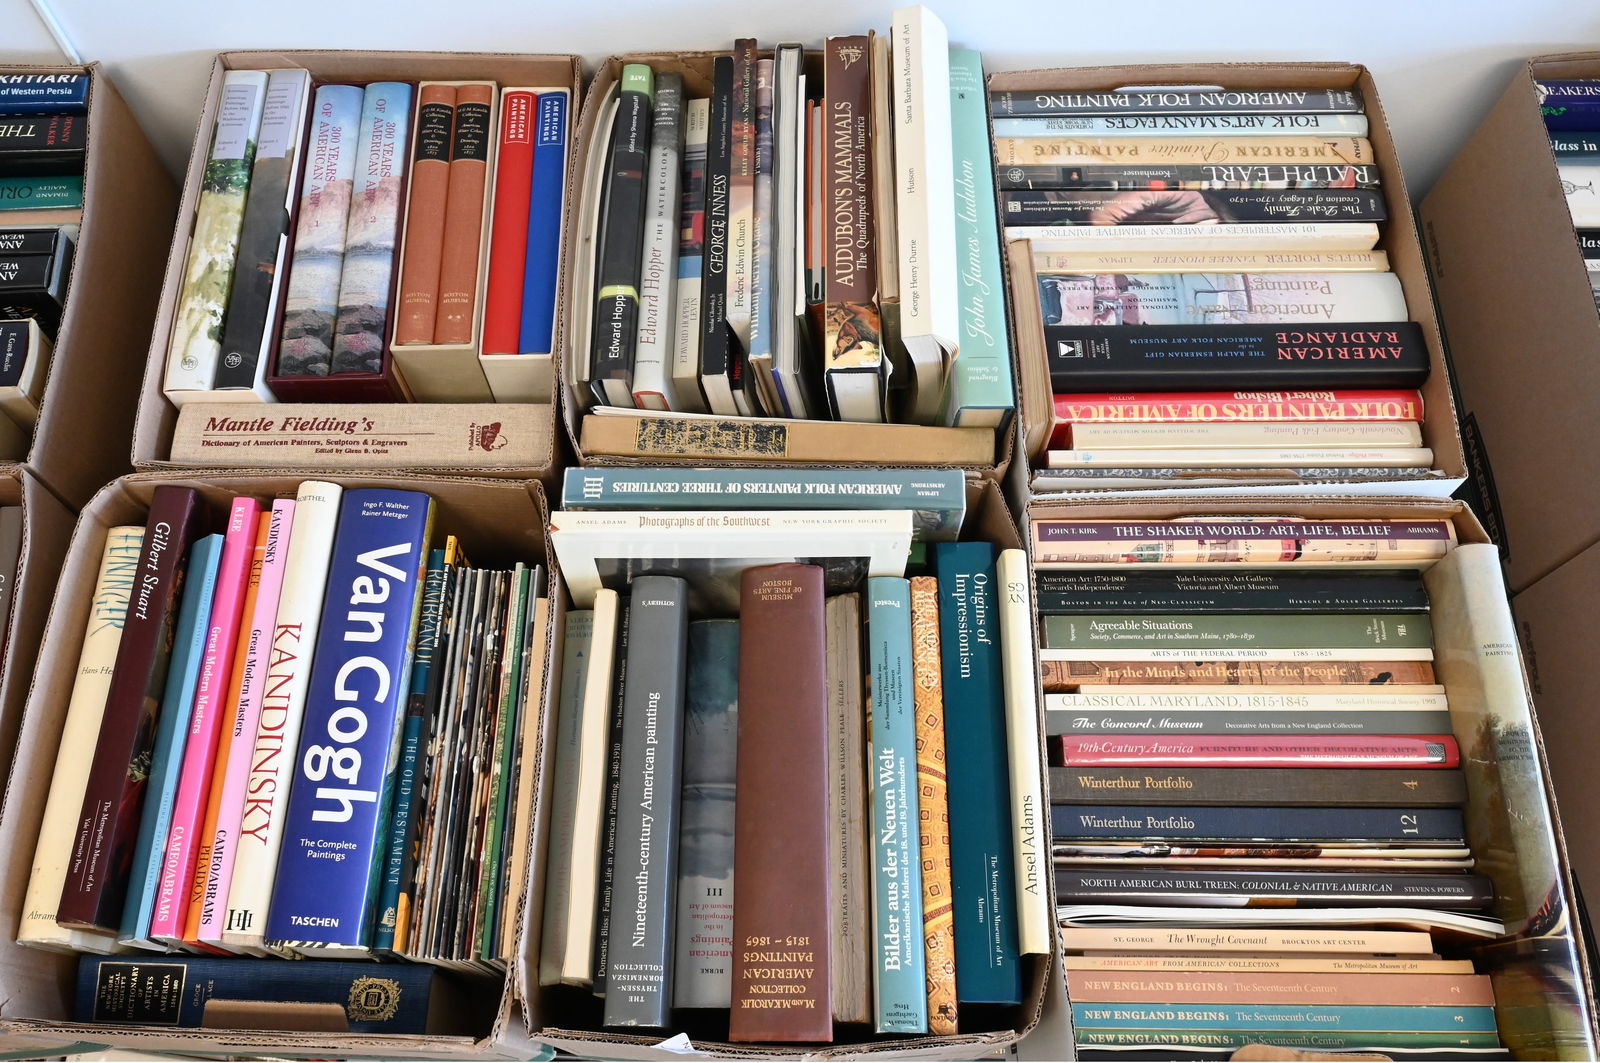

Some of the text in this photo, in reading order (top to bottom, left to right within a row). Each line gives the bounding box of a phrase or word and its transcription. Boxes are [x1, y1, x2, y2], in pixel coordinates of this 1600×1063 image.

[1, 86, 72, 96] of Western Persia
[376, 98, 386, 111] OF
[1034, 92, 1306, 108] AMERICAN FOLK PAINTING
[322, 103, 332, 116] OF
[508, 98, 518, 140] PAINTINGS
[516, 98, 526, 140] AMERICAN
[542, 100, 552, 142] PAINTINGS
[550, 100, 560, 141] AMERICAN
[312, 121, 332, 180] AMERICAN
[326, 126, 342, 182] 300 YEARS
[368, 117, 386, 176] AMERICAN
[381, 122, 397, 178] 300 YEARS
[1123, 170, 1170, 178] Kornhauser
[1202, 165, 1368, 182] RALPH EARL
[834, 102, 854, 287] AUDUBON'S MAMMALS
[854, 116, 870, 270] The Quadrupeds of North America
[709, 174, 726, 274] GEORGE INNESS
[1263, 205, 1362, 216] The Peale Family
[640, 146, 668, 344] Edward Hopper THE WATERCOLORS
[954, 160, 994, 347] John James Audubon
[735, 219, 746, 307] Frederic Edwin Church
[609, 285, 626, 358] Edward Hopper
[1275, 332, 1399, 344] RADIANCE
[1277, 347, 1403, 360] AMERICAN
[204, 416, 375, 434] Mantle Fielding's
[1066, 401, 1415, 421] FOLK PAINTERS OF AMERICA
[202, 439, 241, 448] Dictionary
[291, 438, 323, 448] Painters,
[326, 438, 360, 448] Sculptors
[362, 438, 369, 446] &
[371, 438, 408, 448] Engravers
[612, 481, 903, 496] AMERICAN FOLK PAINTERS OF THREE CENTURIES
[231, 506, 245, 532] KLEE
[1113, 525, 1392, 537] THE SHAKER WORLD: ART, LIFE, BELIEF
[264, 508, 283, 565] KANDINSKY
[135, 521, 171, 620] Gilbert Stuart
[249, 559, 262, 589] KLEE
[874, 600, 900, 608] Prestel
[970, 573, 992, 644] Origins of
[952, 573, 973, 679] Impressionism
[1090, 620, 1193, 633] Agreeable Situations
[192, 626, 222, 734] Great Modern Masters
[234, 629, 262, 737] Great Modern Masters
[303, 542, 412, 823] Van Gogh
[240, 622, 302, 846] KANDINSKY
[1072, 717, 1204, 729] The Concord Museum
[1078, 776, 1193, 789] Winterthur Portfolio
[1402, 780, 1418, 790] 4
[102, 800, 112, 812] The
[388, 737, 418, 885] THE OLD TESTAMENT
[632, 692, 660, 948] Nineteenth-century American painting
[94, 813, 109, 849] Metropolitan
[1080, 815, 1195, 829] Winterthur Portfolio
[1400, 814, 1419, 835] 12
[73, 818, 92, 874] Yale University Press
[299, 839, 357, 850] The Complete
[307, 850, 346, 860] Paintings
[879, 747, 902, 971] Bilder aus der Neuen Welt
[1020, 795, 1039, 896] Ansel Adams
[89, 849, 102, 874] Museum
[158, 826, 184, 921] CAMEO/ABRAMS
[191, 845, 210, 903] PHAIDON
[85, 882, 94, 892] Art
[201, 830, 227, 926] CAMEO/ABRAMS
[1080, 878, 1117, 887] NORTH
[1119, 879, 1173, 888] AMERICAN
[1175, 880, 1202, 889] BURL
[1203, 880, 1240, 889] TREEN:
[1242, 881, 1292, 889] COLONIAL
[1293, 882, 1300, 891] &
[1302, 882, 1339, 891] NATIVE
[1340, 883, 1393, 892] AMERICAN
[290, 915, 339, 928] TASCHEN
[743, 952, 814, 962] PAINTINGS
[742, 968, 814, 978] AMERICAN
[749, 984, 806, 993] COLLECTION
